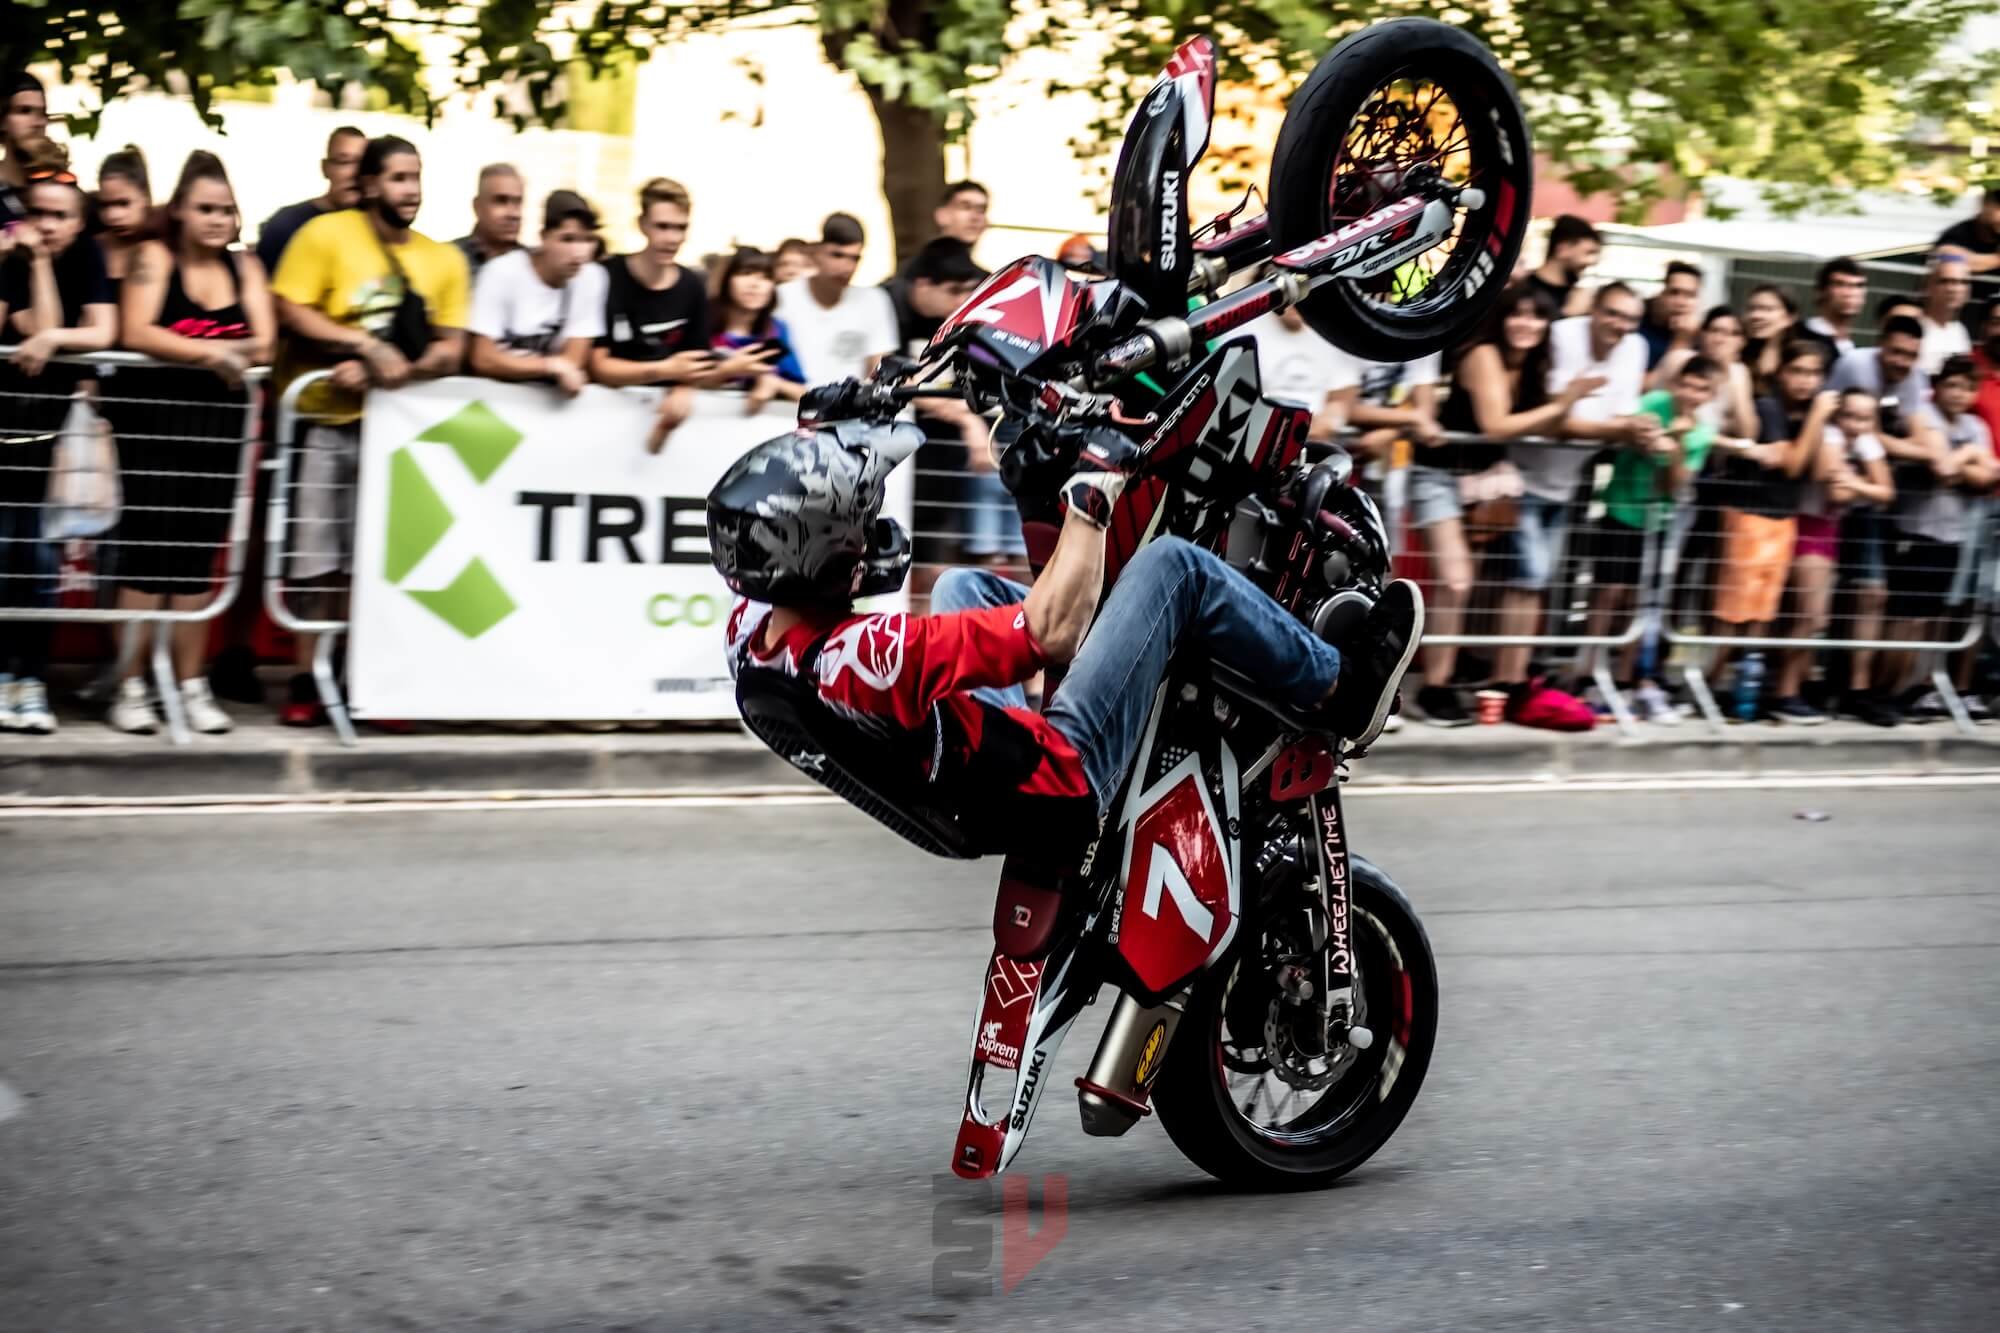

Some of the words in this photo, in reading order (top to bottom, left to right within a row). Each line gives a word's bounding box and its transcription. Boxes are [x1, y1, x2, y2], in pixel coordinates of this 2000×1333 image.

[1160, 170, 1180, 271] SUZUKI
[1330, 219, 1412, 271] DR-Z
[1140, 373, 1211, 455] SUPERMOTO
[1142, 841, 1215, 944] 7
[1321, 804, 1350, 975] WHEELIETIME
[978, 1030, 1019, 1061] Suprem
[1011, 1049, 1047, 1132] SUZUKI
